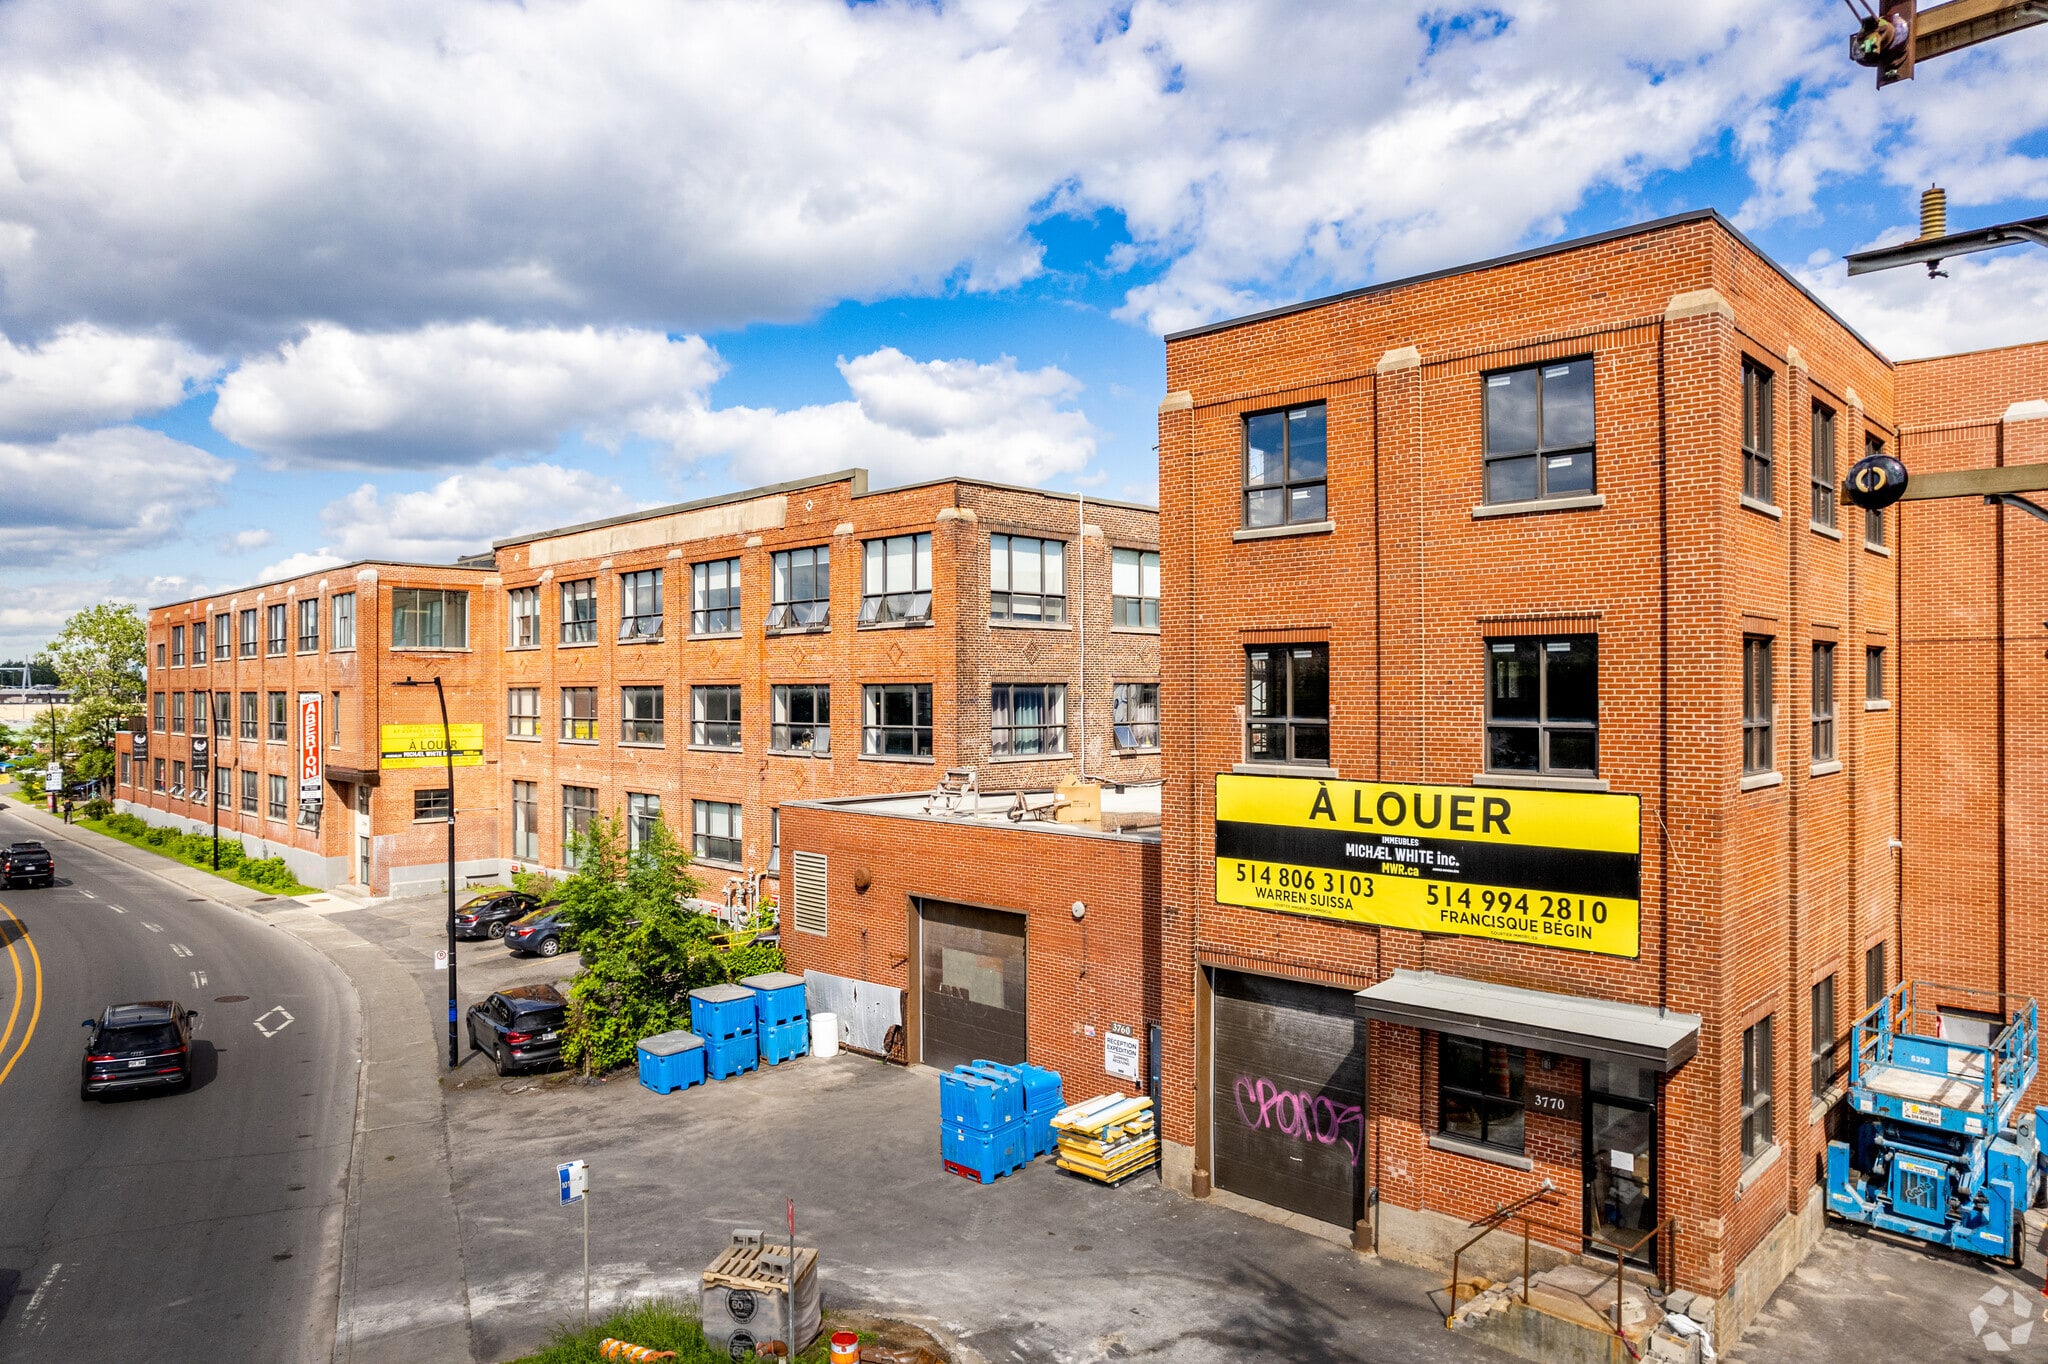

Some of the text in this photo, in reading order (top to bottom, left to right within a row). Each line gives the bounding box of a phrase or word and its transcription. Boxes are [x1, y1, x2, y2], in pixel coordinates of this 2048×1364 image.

[305, 703, 316, 778] ABERTON
[409, 739, 417, 750] À
[1309, 781, 1511, 834] À LOUER
[1381, 836, 1419, 847] IMMEUBLES
[1345, 843, 1460, 867] MICHÆL WHITE inc.
[1236, 863, 1374, 898] 514 806 3103
[1381, 862, 1420, 877] MWR.ca
[1255, 886, 1354, 910] WARREN SUISSA
[1426, 884, 1607, 924] 514 994 2810
[1440, 909, 1593, 939] FRANCISQUE BÉGIN
[1112, 1023, 1131, 1035] 3760
[1534, 1094, 1565, 1111] 3770
